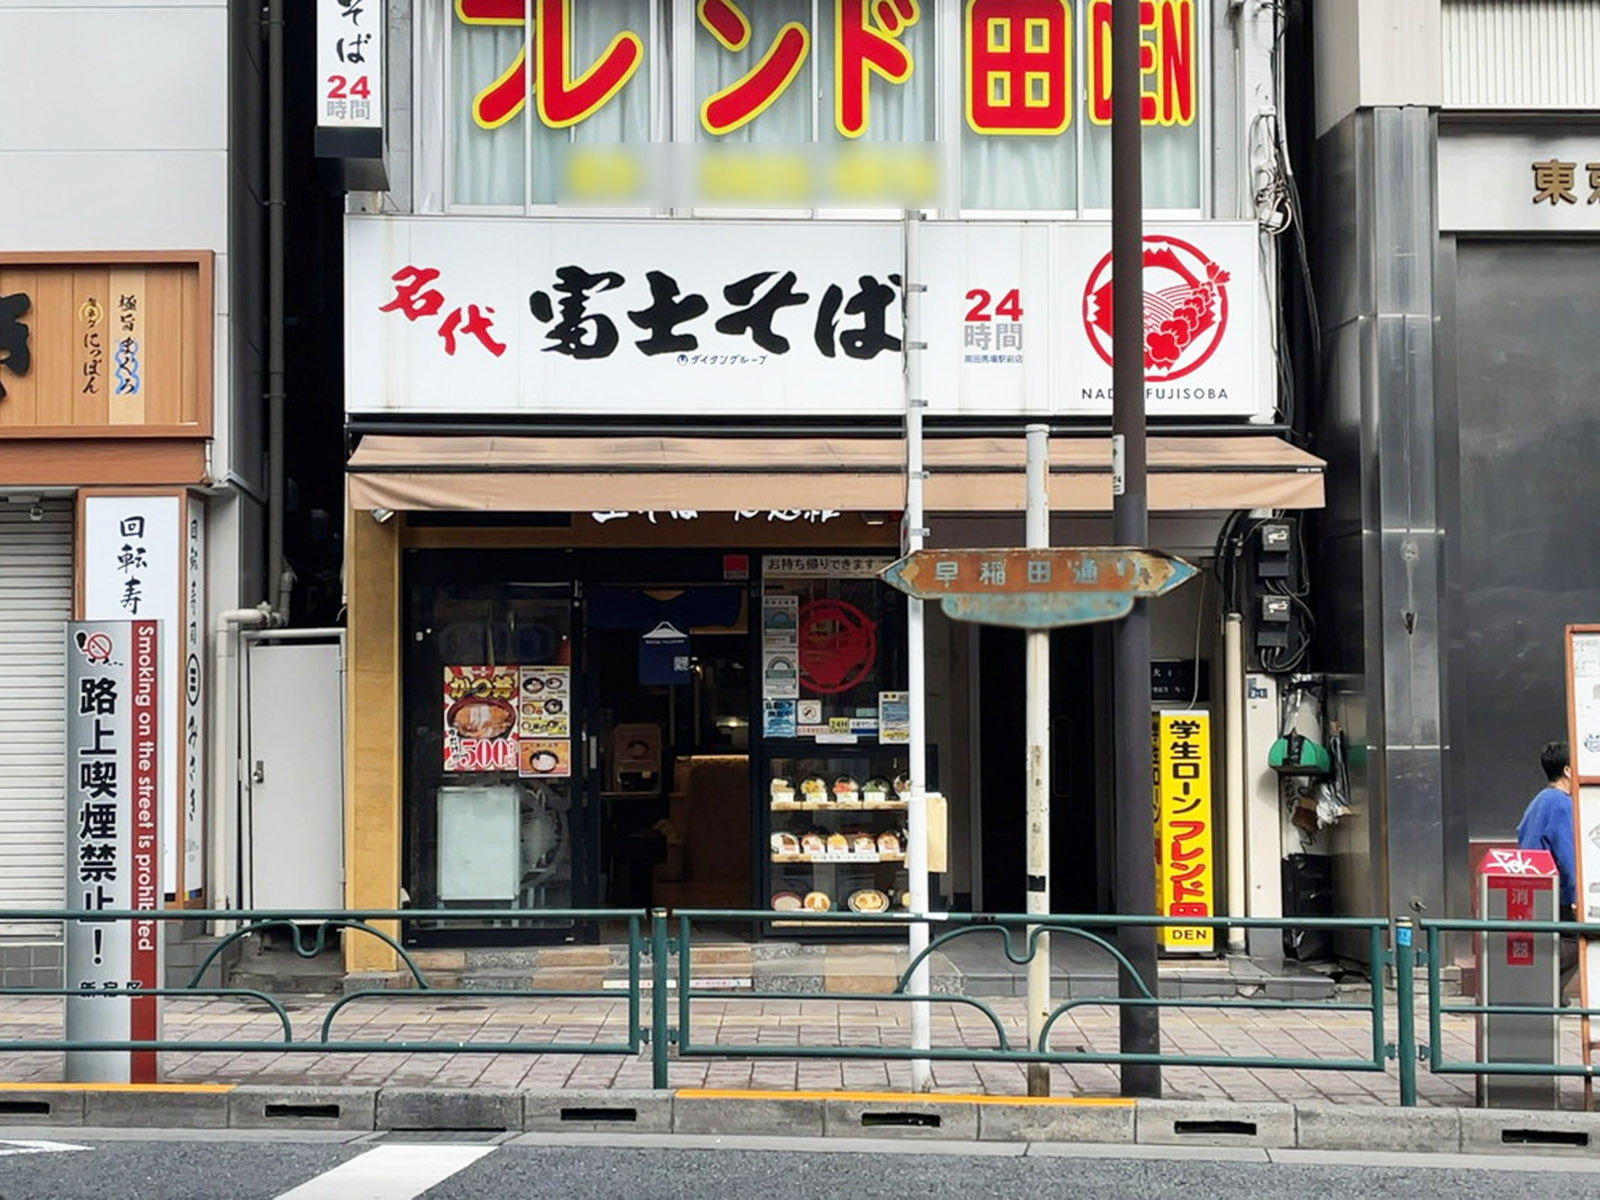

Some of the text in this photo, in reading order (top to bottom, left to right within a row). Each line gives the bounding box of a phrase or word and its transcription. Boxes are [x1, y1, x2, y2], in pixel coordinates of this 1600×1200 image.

[327, 75, 371, 99] 24
[326, 100, 371, 120] 時間
[379, 265, 507, 357] 名代
[964, 288, 1024, 322] 24
[964, 323, 1024, 351] 時間
[1145, 387, 1229, 400] FUJISOBA
[460, 738, 509, 768] 500
[1169, 719, 1202, 815] 学生ローン
[135, 625, 155, 951] Smoking on the street is prohibted
[1172, 929, 1207, 940] DEN
[1511, 887, 1529, 958] 消器
